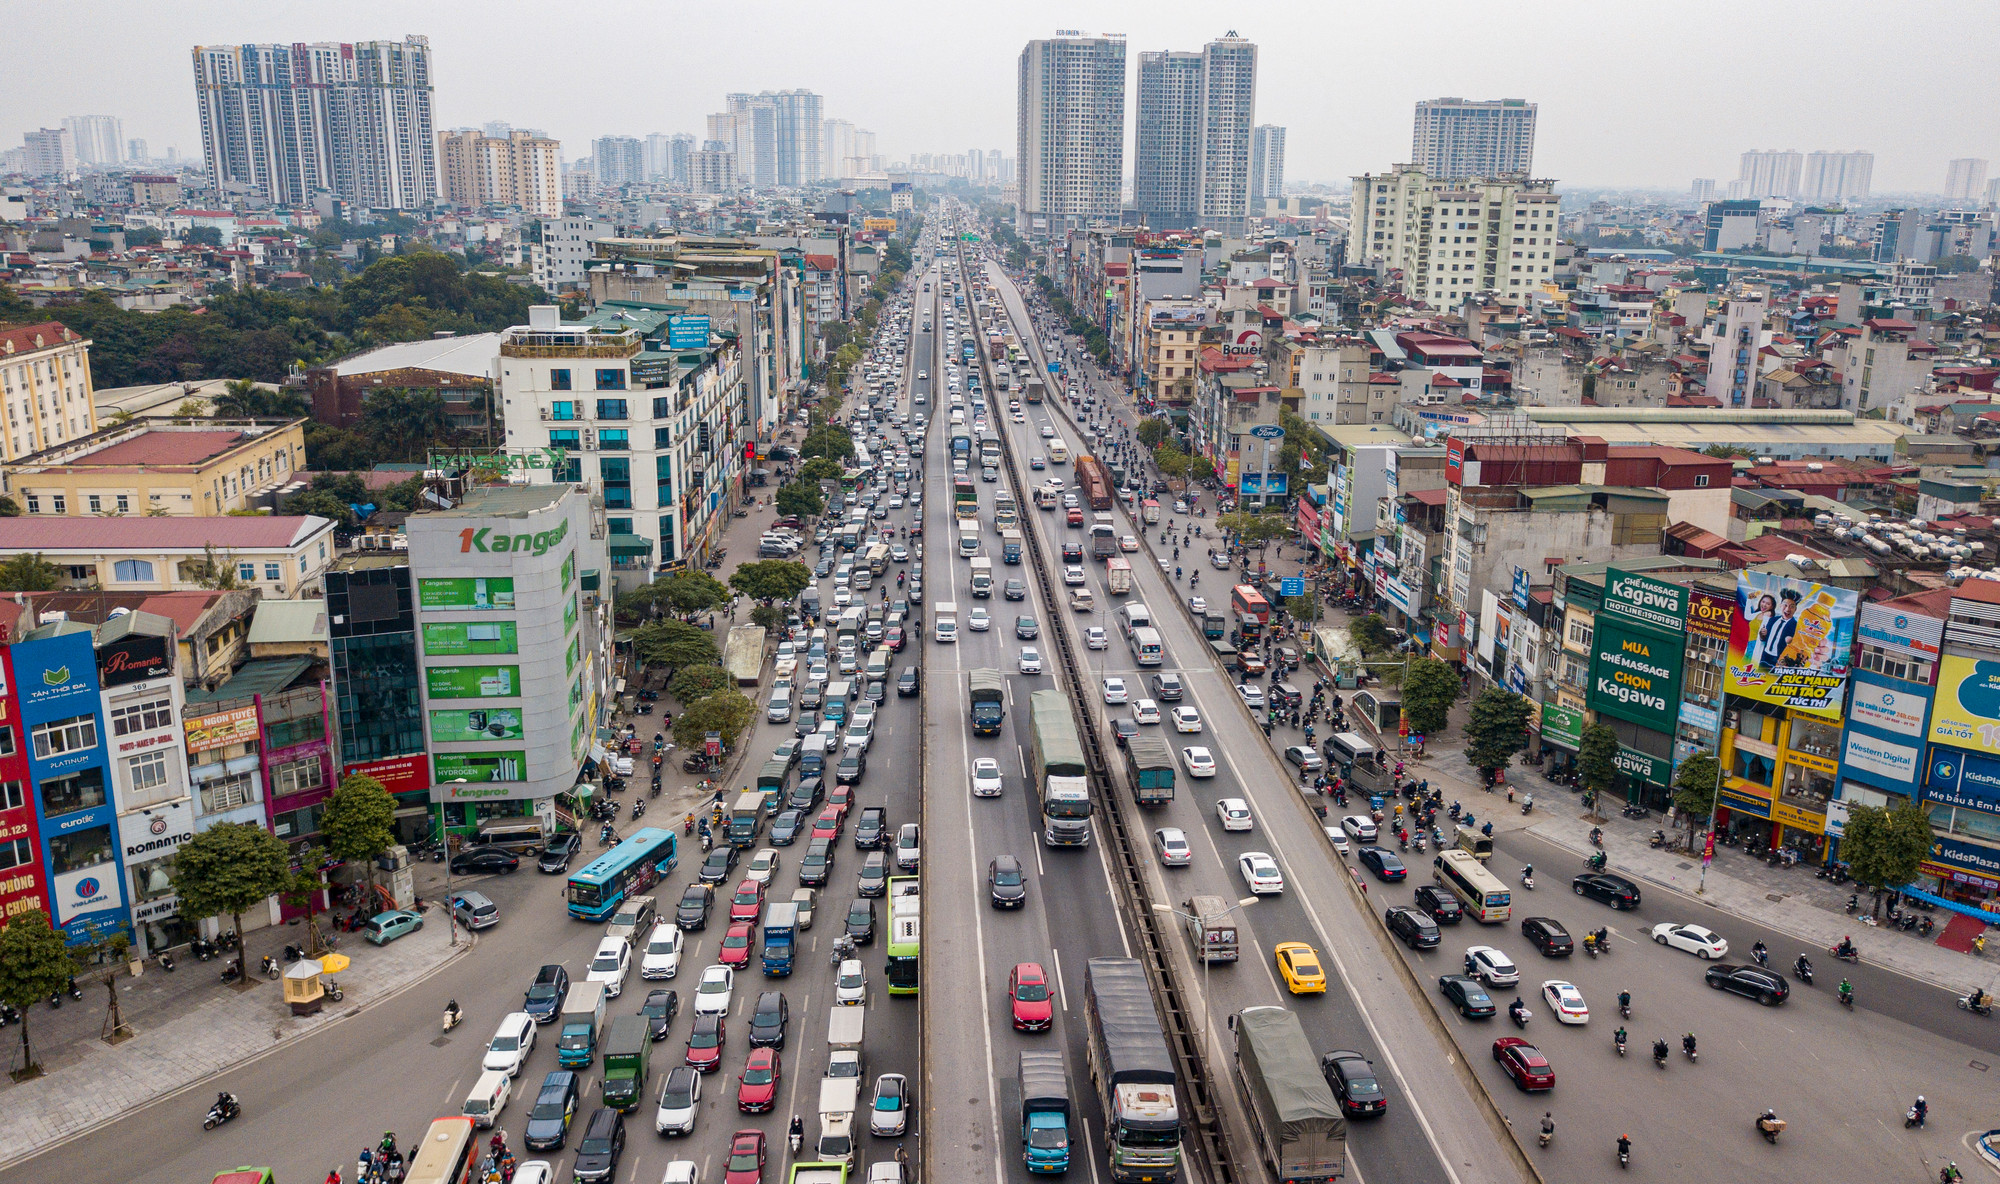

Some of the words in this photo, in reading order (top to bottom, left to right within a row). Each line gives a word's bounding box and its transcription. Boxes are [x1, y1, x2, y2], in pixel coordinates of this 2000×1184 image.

[1223, 344, 1263, 355] Bauer
[1257, 428, 1278, 436] Ford
[1612, 580, 1678, 612] Kagawa
[1624, 578, 1642, 587] GHẾ
[1642, 582, 1679, 598] MASSAGE
[1688, 602, 1733, 623] TOPY
[1622, 640, 1650, 657] MUA
[104, 651, 162, 673] Romantic
[1601, 652, 1622, 665] GHẾ
[1621, 658, 1670, 679] MASSAGE
[1730, 665, 1762, 678] Number
[1614, 671, 1651, 691] CHỌN
[1782, 673, 1803, 684] SỨC
[1804, 676, 1840, 688] MẠNH
[1796, 668, 1817, 676] THÊM
[1598, 677, 1665, 710] Kagawa
[1800, 684, 1826, 698] TÁO
[185, 720, 202, 730] 379
[204, 714, 229, 726] NGON
[230, 708, 256, 720] TUYỆT
[1879, 706, 1896, 716] LAPTOP
[1955, 729, 1973, 739] TỐT
[50, 755, 89, 769] PLATINUM
[1622, 751, 1652, 766] MASSAGE
[1850, 742, 1882, 758] Western
[1884, 751, 1911, 765] Digital
[1613, 756, 1651, 776] gawa
[1929, 790, 1944, 800] Mẹ
[1946, 793, 1966, 805] bầu
[1968, 798, 1975, 806] &
[1976, 800, 1993, 810] Em
[60, 814, 94, 829] eurotile
[127, 832, 192, 856] ROMANTIC
[1944, 849, 2000, 870] KidsPlaza
[0, 874, 35, 895] PHÒNG
[624, 878, 640, 893] SPORT
[6, 896, 41, 915] CHỨNG
[154, 902, 171, 913] VIỆN
